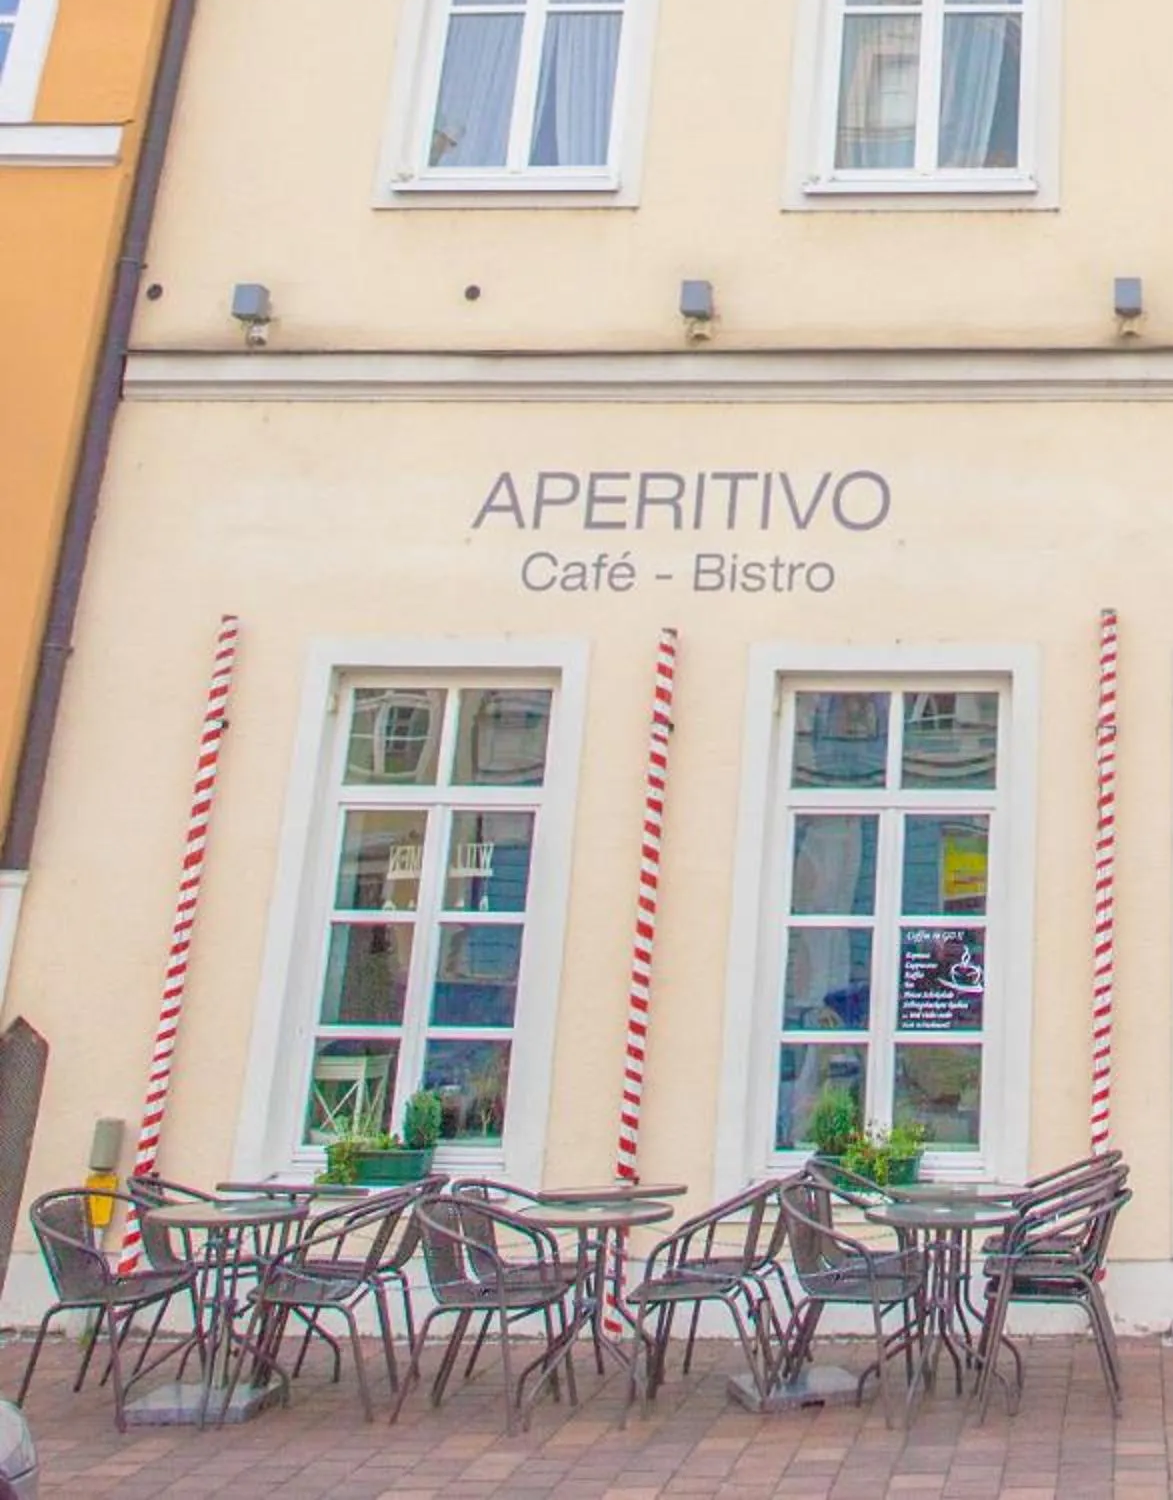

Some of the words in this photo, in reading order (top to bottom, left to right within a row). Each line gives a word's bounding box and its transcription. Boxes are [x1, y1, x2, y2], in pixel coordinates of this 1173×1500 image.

[470, 469, 893, 532] APERITIVO
[520, 550, 637, 593] Café
[692, 552, 836, 593] Bistro
